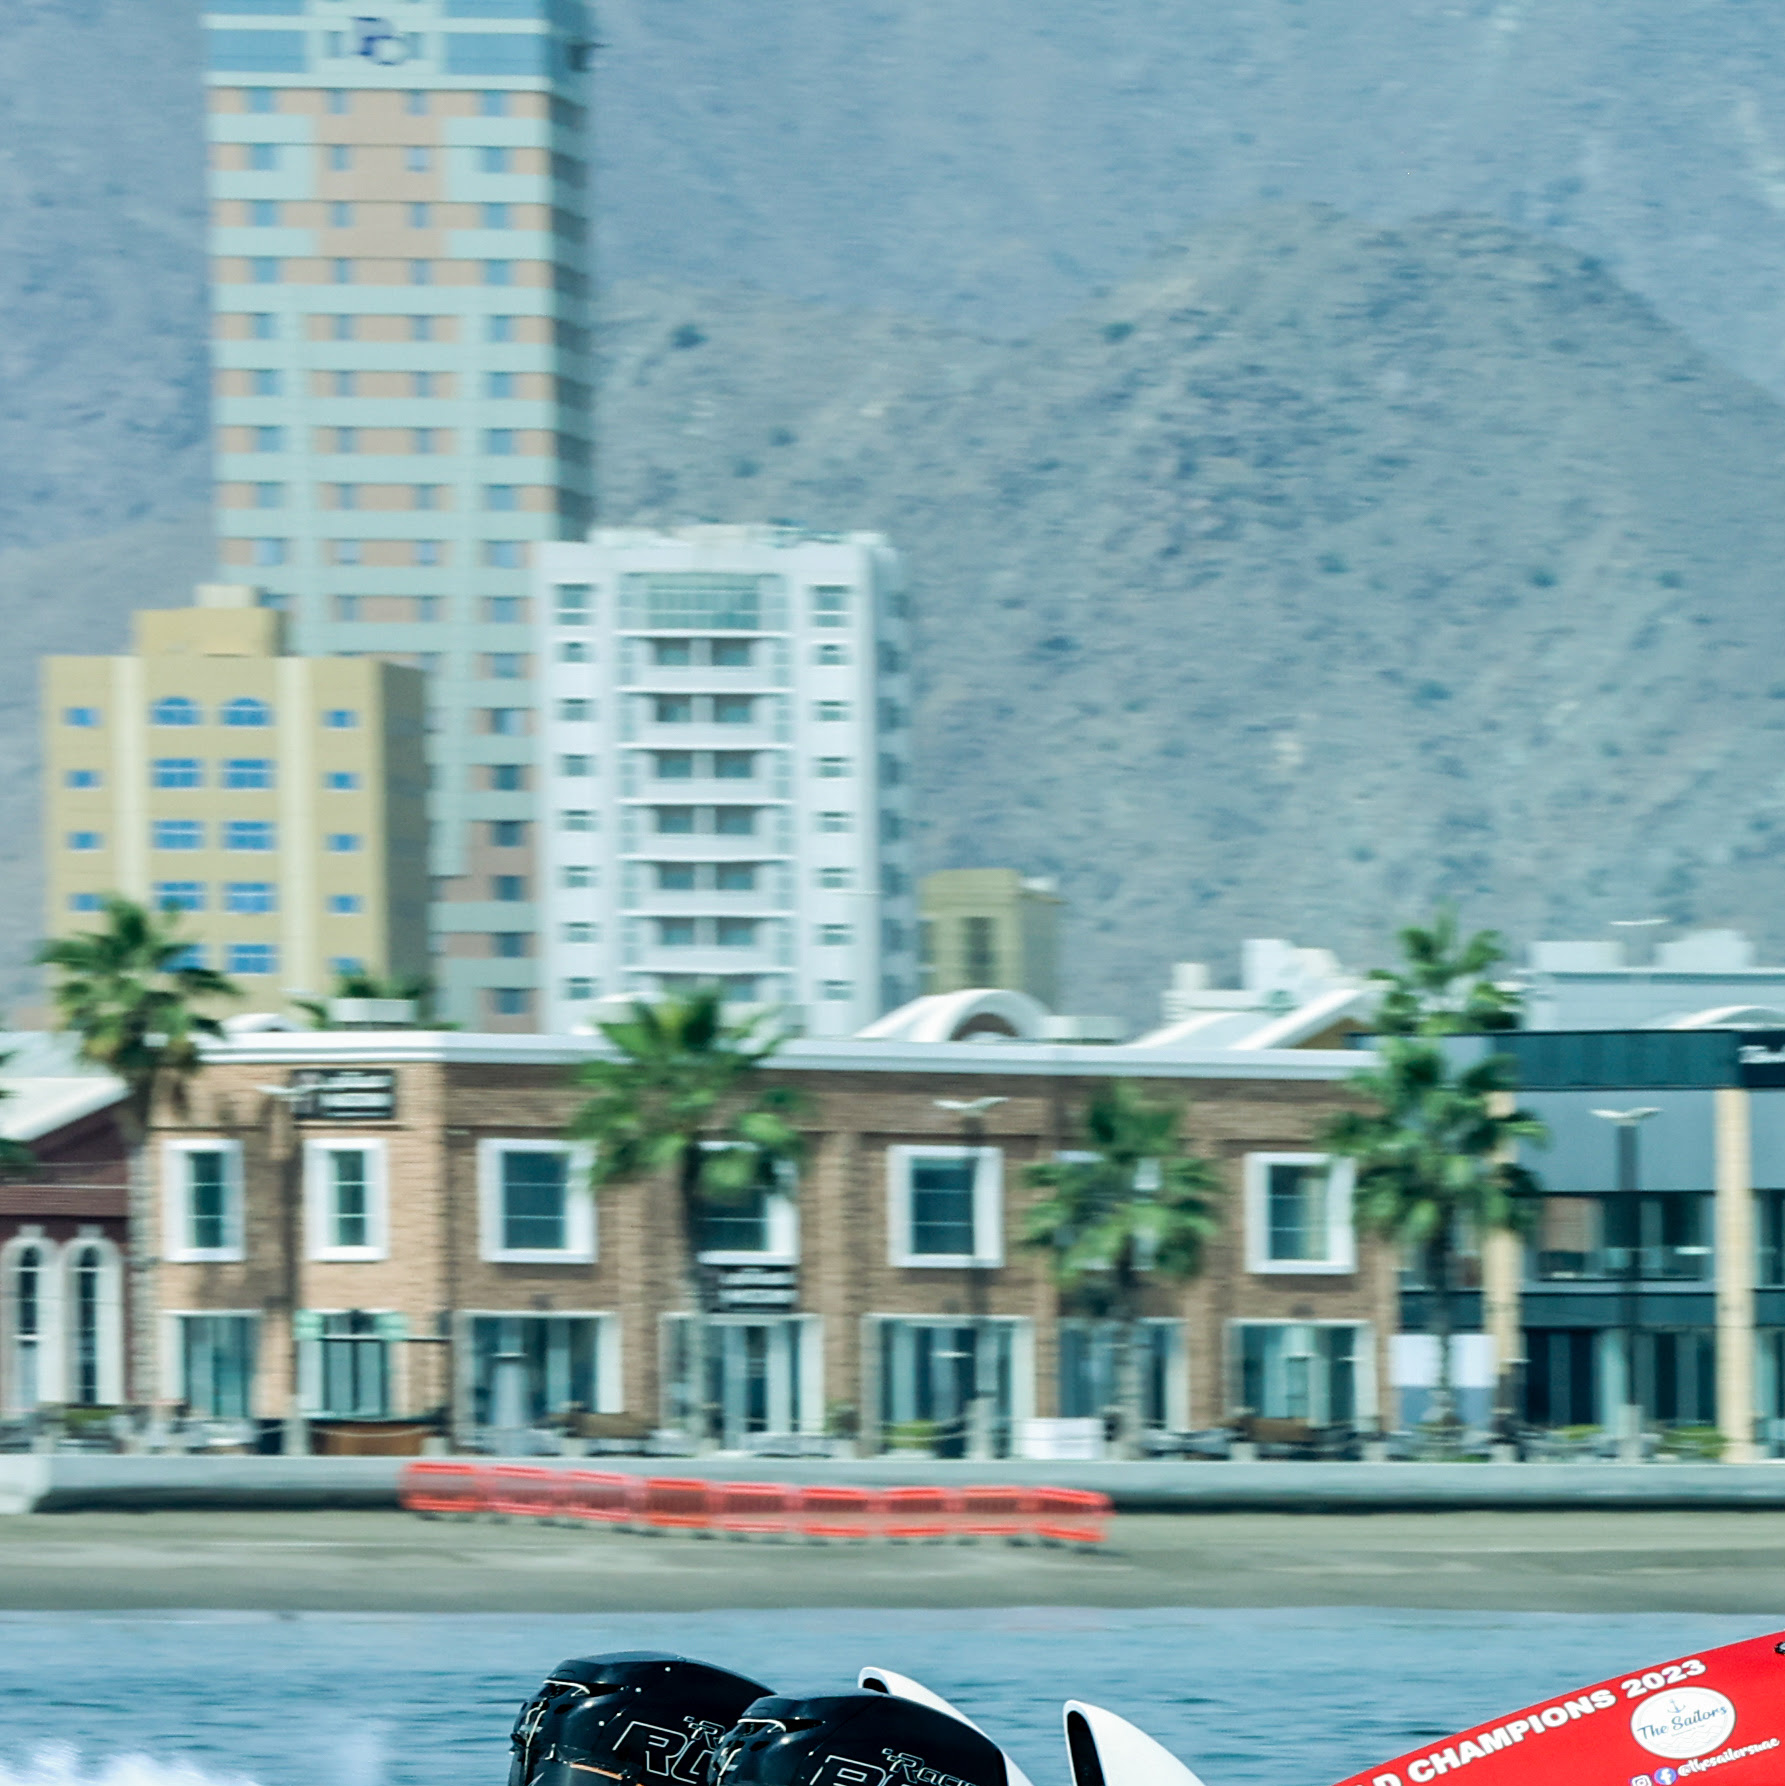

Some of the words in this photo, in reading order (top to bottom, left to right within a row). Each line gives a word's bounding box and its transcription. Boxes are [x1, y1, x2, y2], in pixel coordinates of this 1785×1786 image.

[1407, 1689, 1617, 1783] CHAMPIONS
[1621, 1659, 1707, 1699] 2023
[1637, 1724, 1668, 1740] The
[1671, 1706, 1727, 1731] Sailors
[1677, 1738, 1780, 1776] @thesailorsuae
